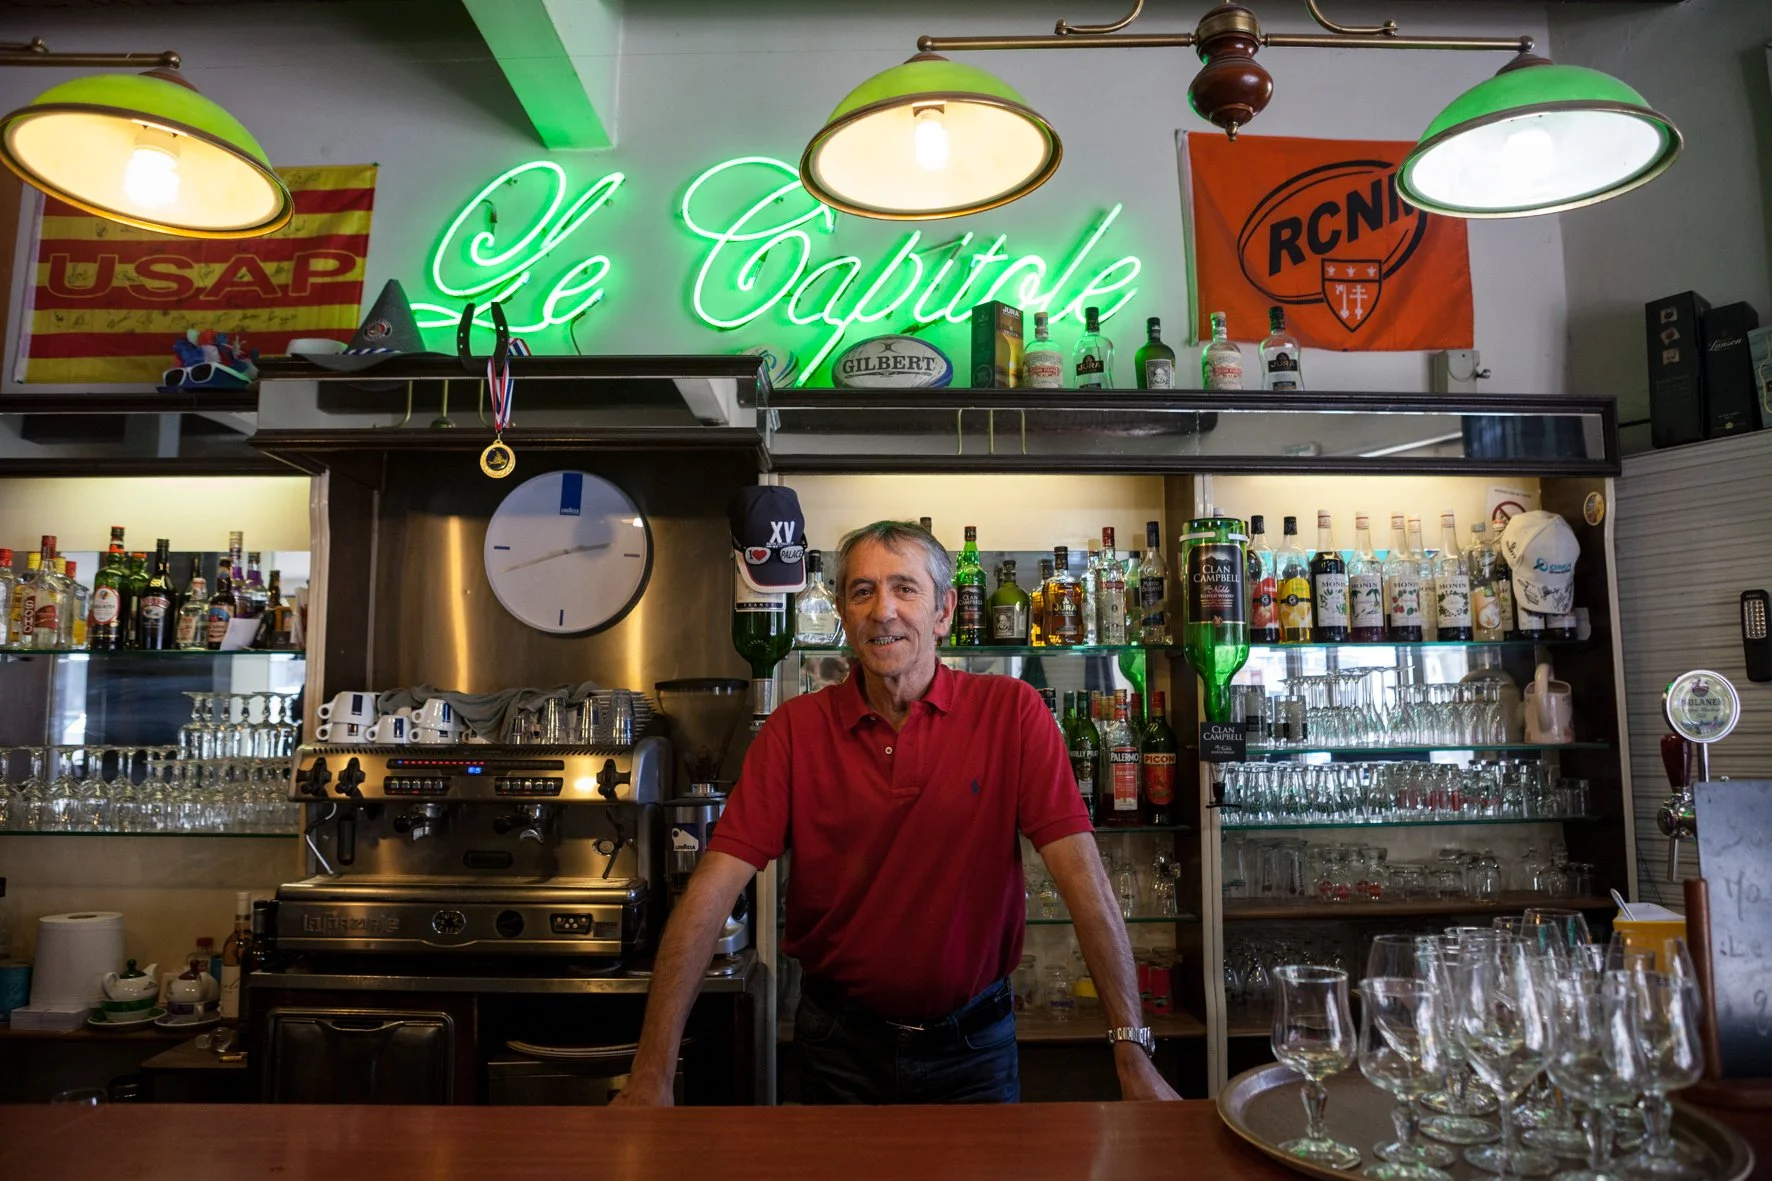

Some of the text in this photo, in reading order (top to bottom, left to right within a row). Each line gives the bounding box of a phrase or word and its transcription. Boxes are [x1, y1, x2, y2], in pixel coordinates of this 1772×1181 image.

[47, 249, 357, 300] USAP
[681, 155, 1142, 388] Capitole
[1002, 305, 1020, 317] JURA
[842, 355, 935, 374] GILBERT
[1078, 361, 1100, 372] JURA
[1270, 360, 1295, 369] JURA
[769, 521, 796, 544] XV
[1202, 564, 1231, 574] CLAN
[1193, 573, 1240, 583] CAMPBELL
[1438, 582, 1467, 590] MONIN
[1054, 603, 1077, 612] JURA
[1211, 725, 1235, 734] CLAN
[1203, 732, 1244, 741] CAMPBELL
[1111, 752, 1139, 762] PALERMO
[1145, 755, 1175, 763] PICON
